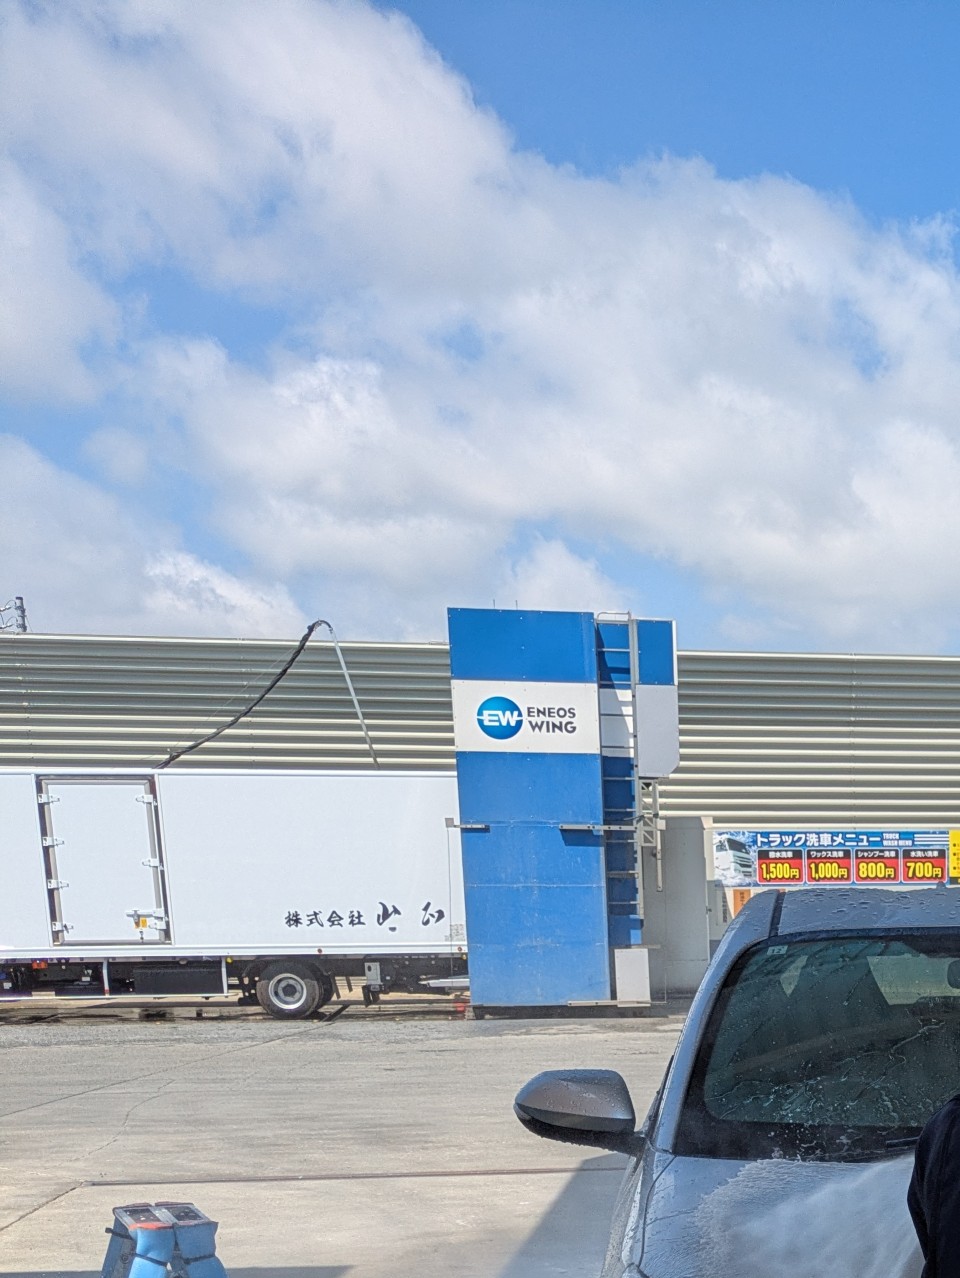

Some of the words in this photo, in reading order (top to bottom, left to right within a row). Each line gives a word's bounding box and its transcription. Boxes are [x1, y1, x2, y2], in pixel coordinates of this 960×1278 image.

[482, 710, 519, 727] EW
[527, 706, 576, 719] ENEOS
[528, 720, 577, 734] WING
[757, 833, 881, 847] トラック洗車メニュー
[761, 863, 800, 880] 1,500円
[809, 862, 848, 880] 1,000円
[859, 862, 895, 878] 800円
[906, 862, 942, 878] 700円
[284, 910, 366, 928] 株式会社
